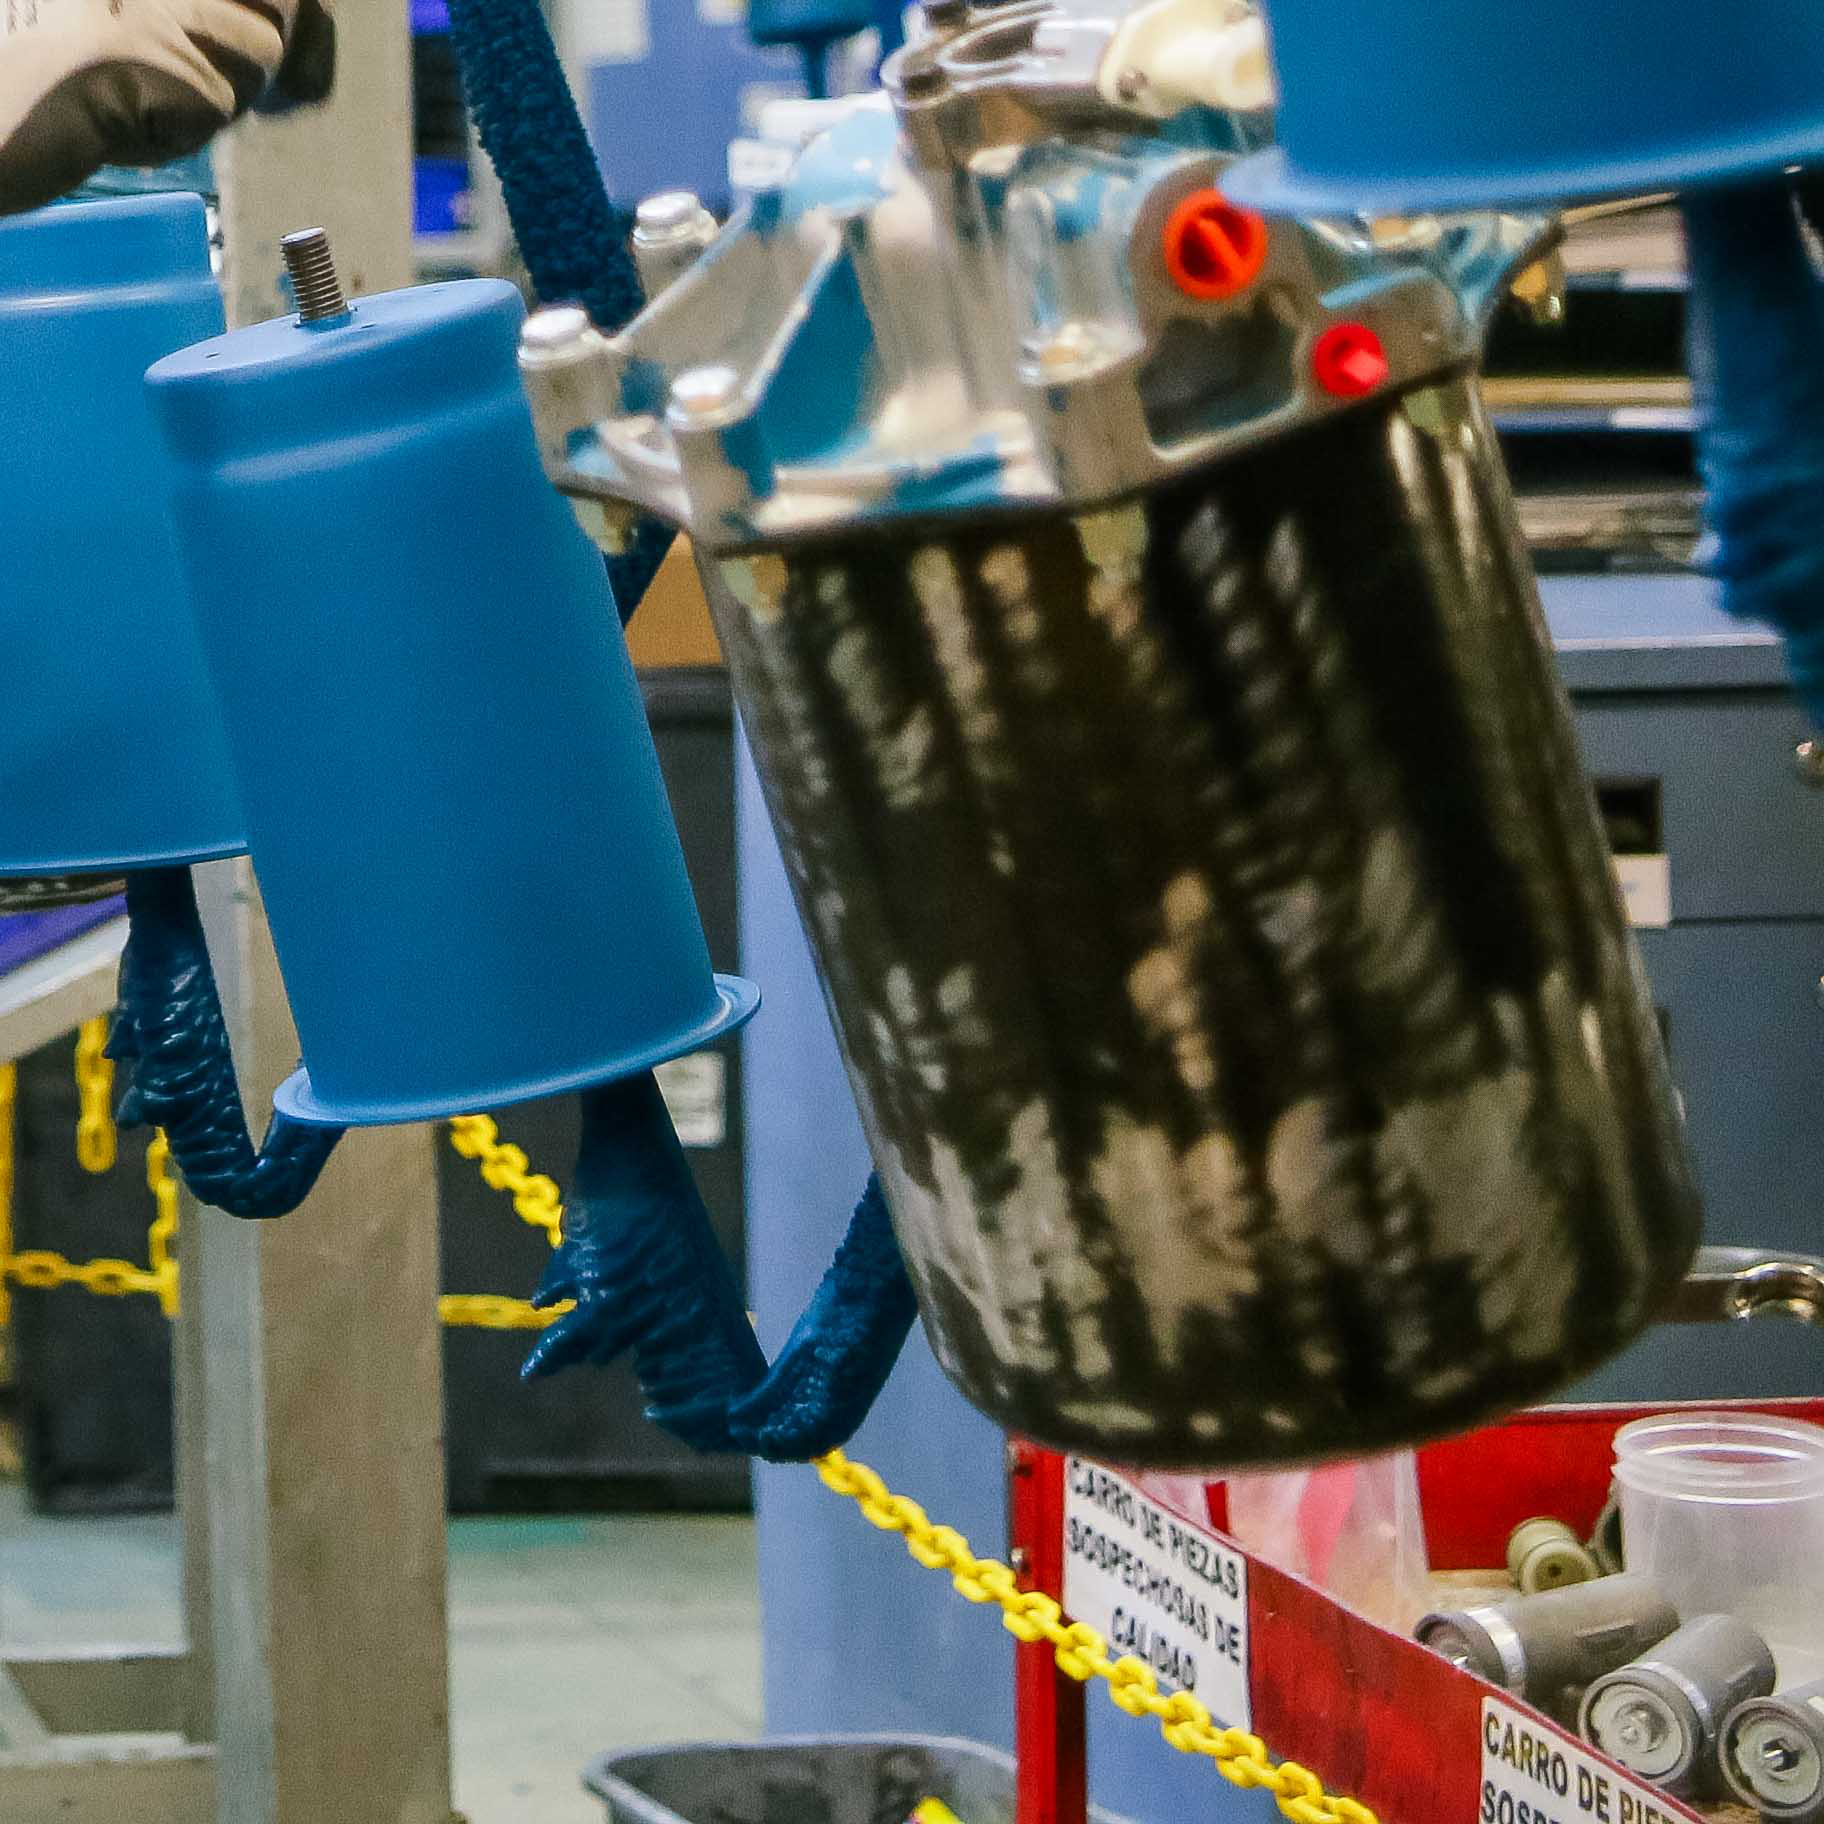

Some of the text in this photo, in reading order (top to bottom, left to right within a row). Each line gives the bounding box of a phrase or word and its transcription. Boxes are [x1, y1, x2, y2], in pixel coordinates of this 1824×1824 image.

[1068, 1517, 1241, 1665] SOSPECHOSAS DE
[1069, 1457, 1240, 1600] CARRO DE PIEZAS
[1110, 1606, 1197, 1692] CALIDAD
[1484, 1711, 1569, 1796] CARRO
[1577, 1763, 1611, 1823] DE
